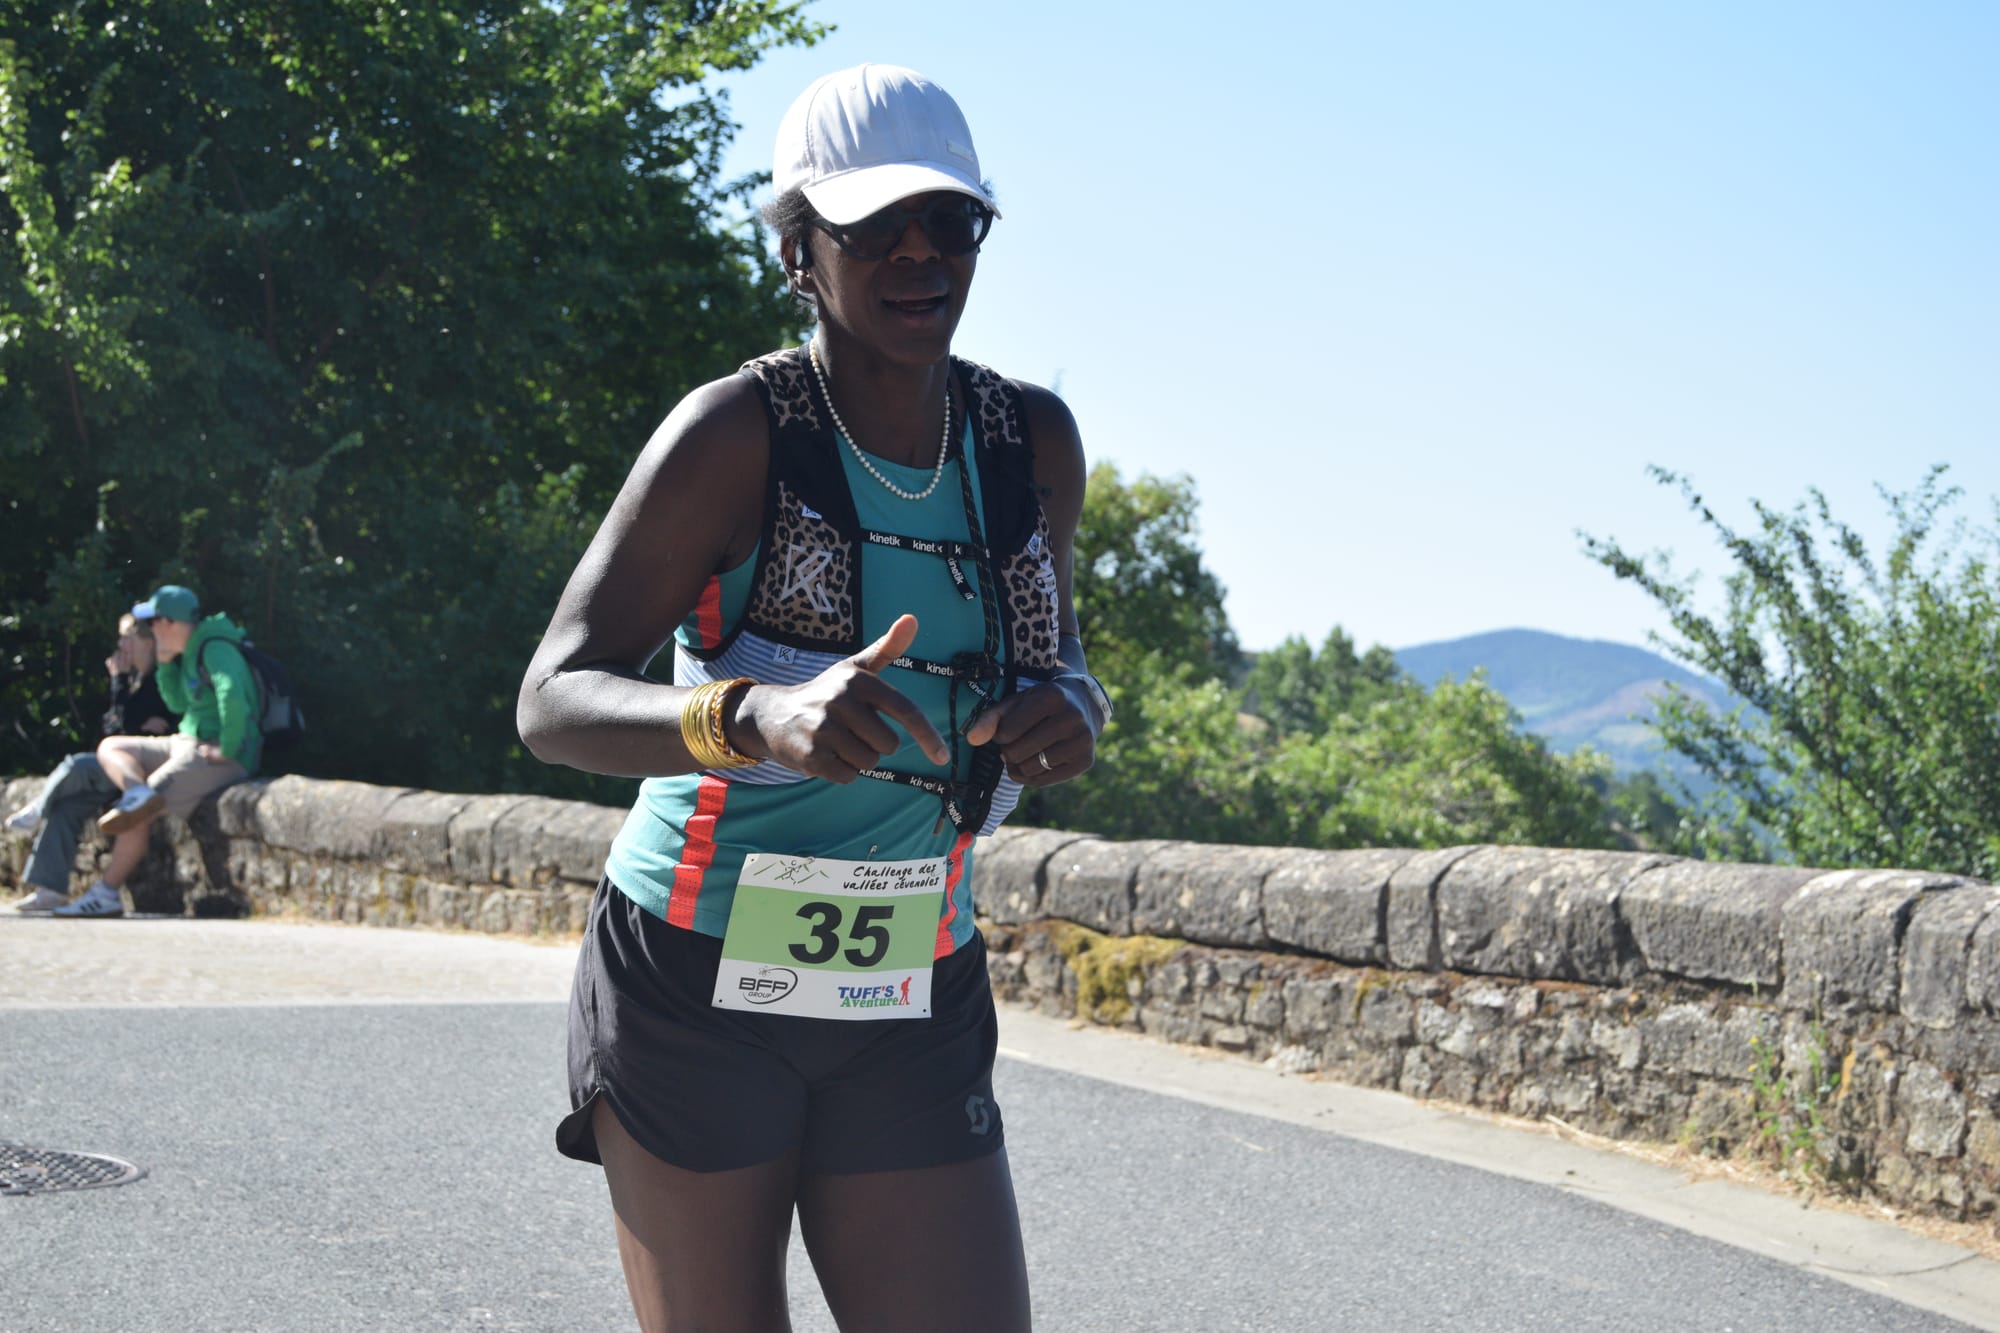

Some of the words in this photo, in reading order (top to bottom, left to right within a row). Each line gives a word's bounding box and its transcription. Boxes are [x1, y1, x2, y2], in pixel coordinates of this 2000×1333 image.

[869, 532, 901, 547] kinetik
[853, 866, 912, 880] Challenge
[918, 863, 937, 874] des
[843, 879, 888, 890] vallées
[894, 876, 940, 890] cévenoles
[788, 902, 895, 967] 35
[738, 976, 789, 993] BFP
[747, 991, 773, 999] GROUP
[838, 985, 895, 1000] TUFF'S
[839, 996, 899, 1008] Aventure
